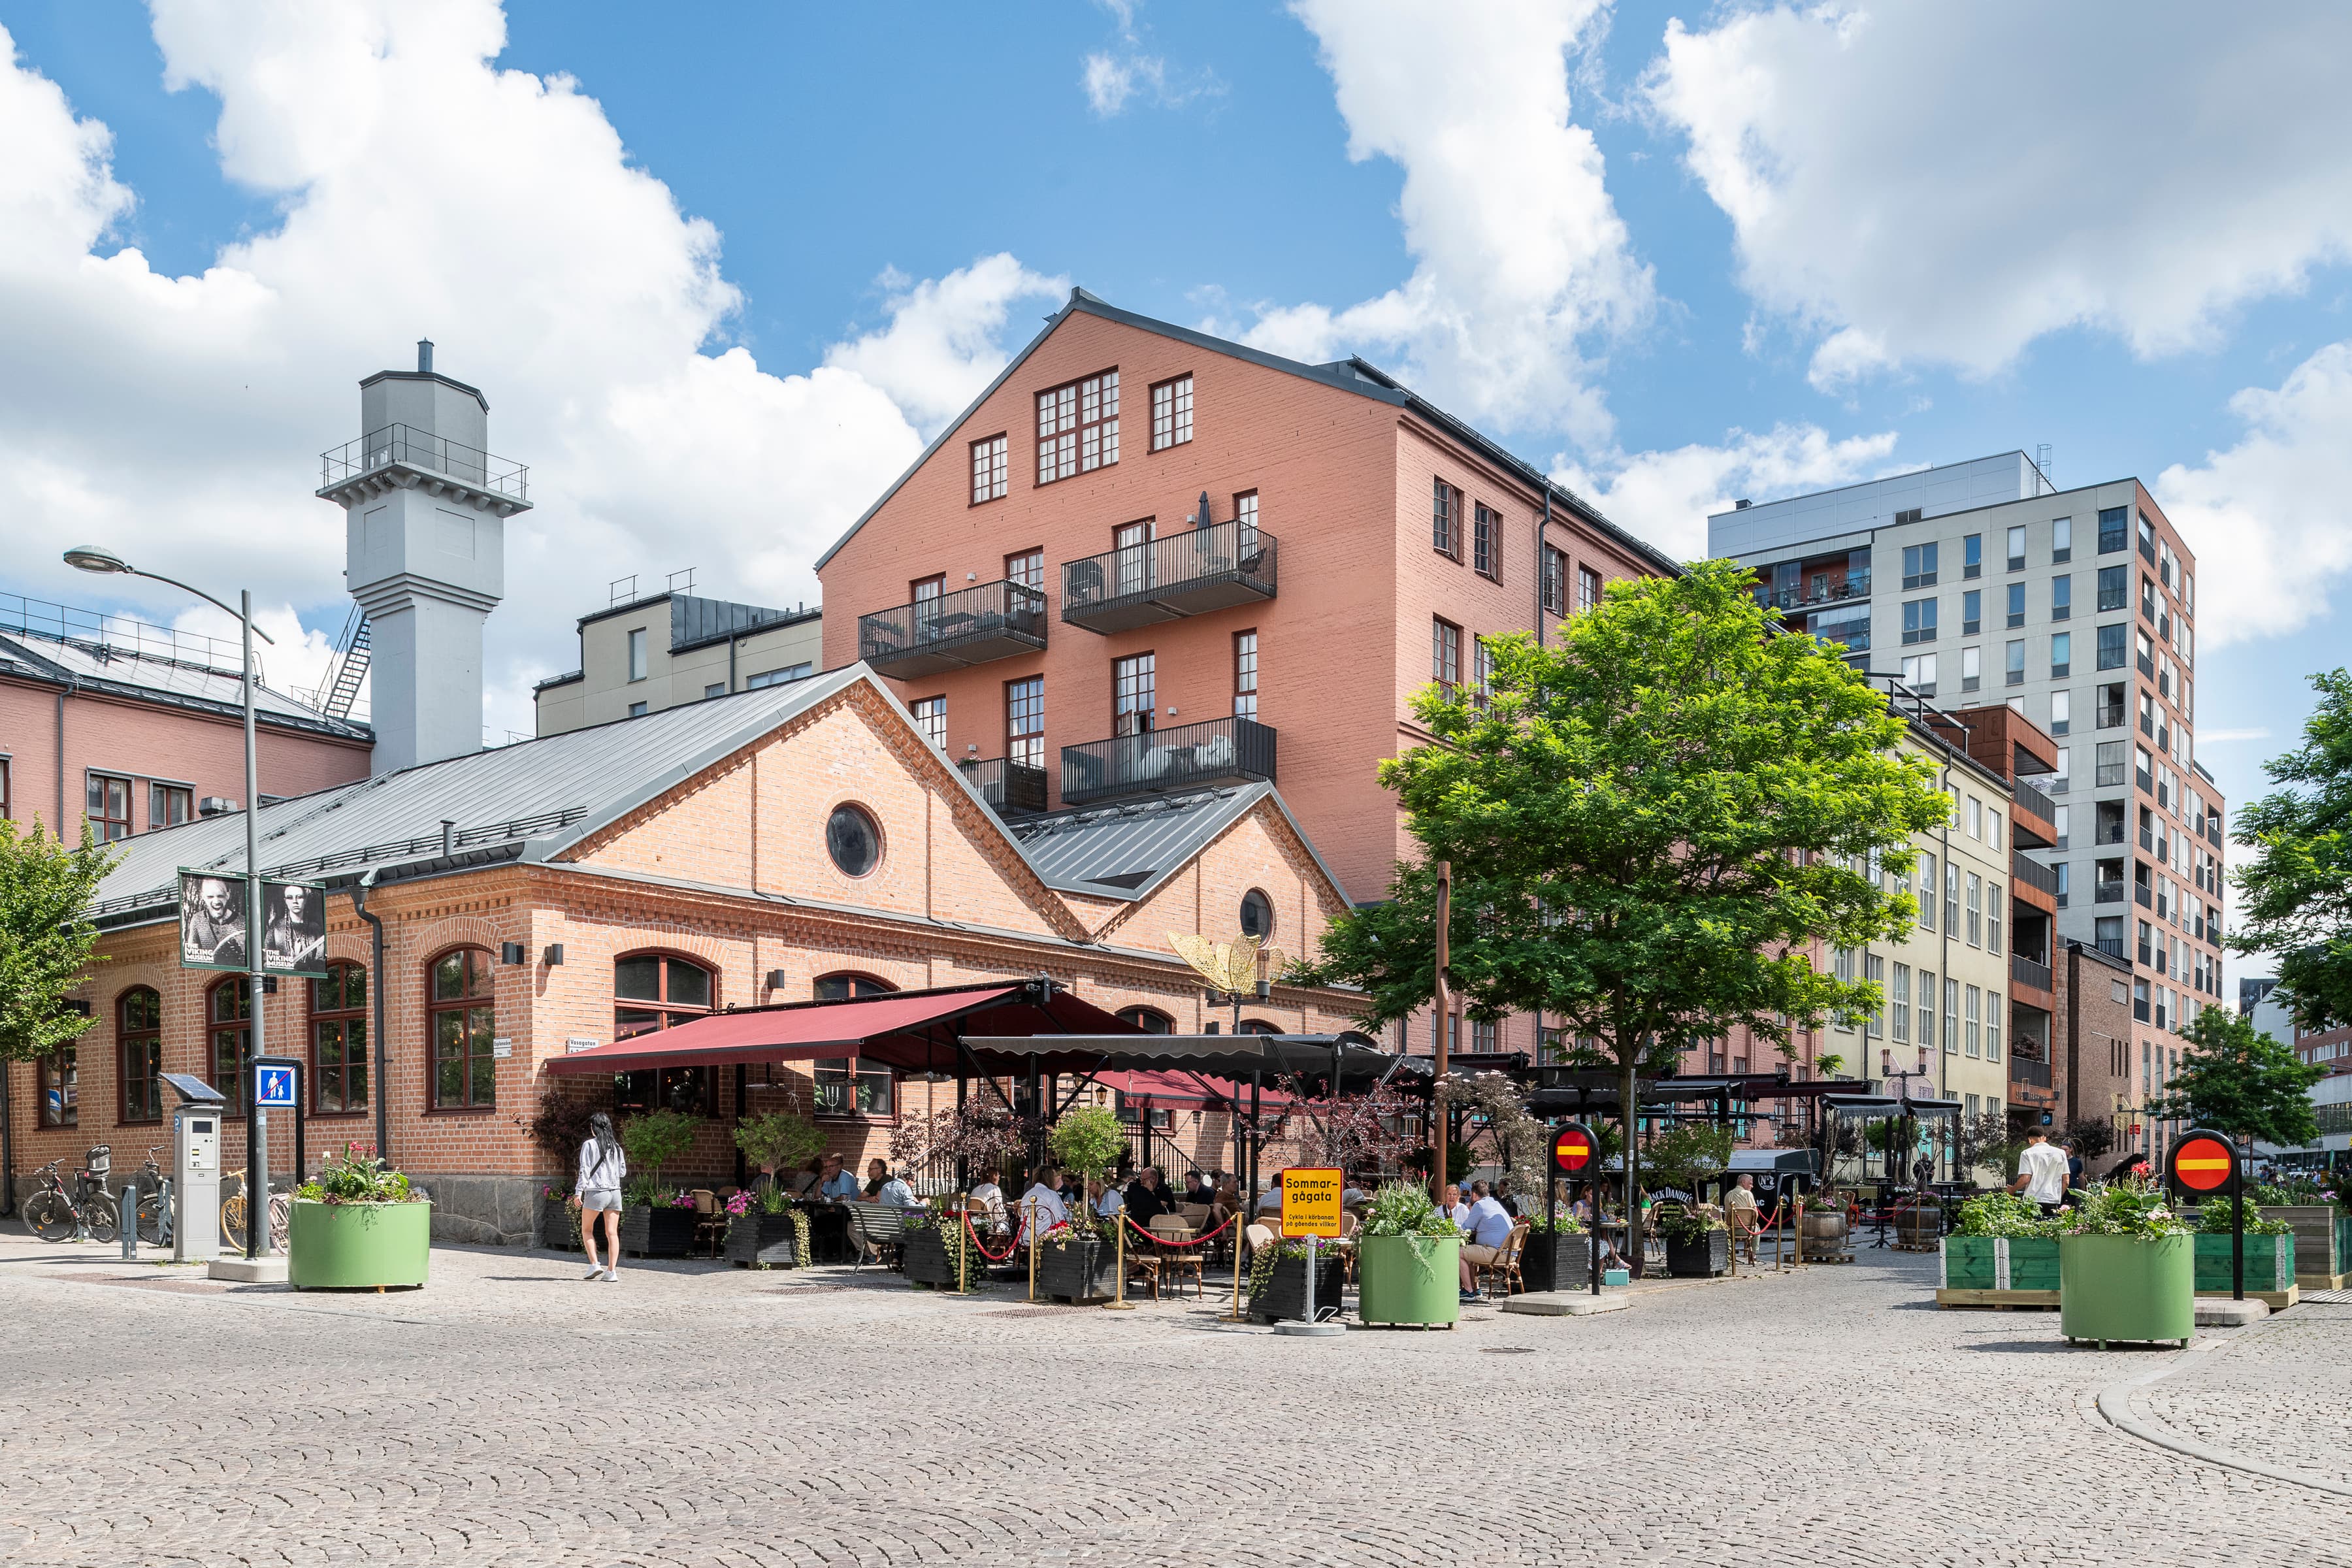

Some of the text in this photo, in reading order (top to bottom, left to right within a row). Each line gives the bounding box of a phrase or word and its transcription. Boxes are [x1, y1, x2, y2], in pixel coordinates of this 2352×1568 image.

[187, 948, 214, 956] VIKING
[1286, 1178, 1338, 1188] Sommar-
[1292, 1190, 1331, 1203] gågata
[1648, 1186, 1693, 1204] JACK DANIEL'S
